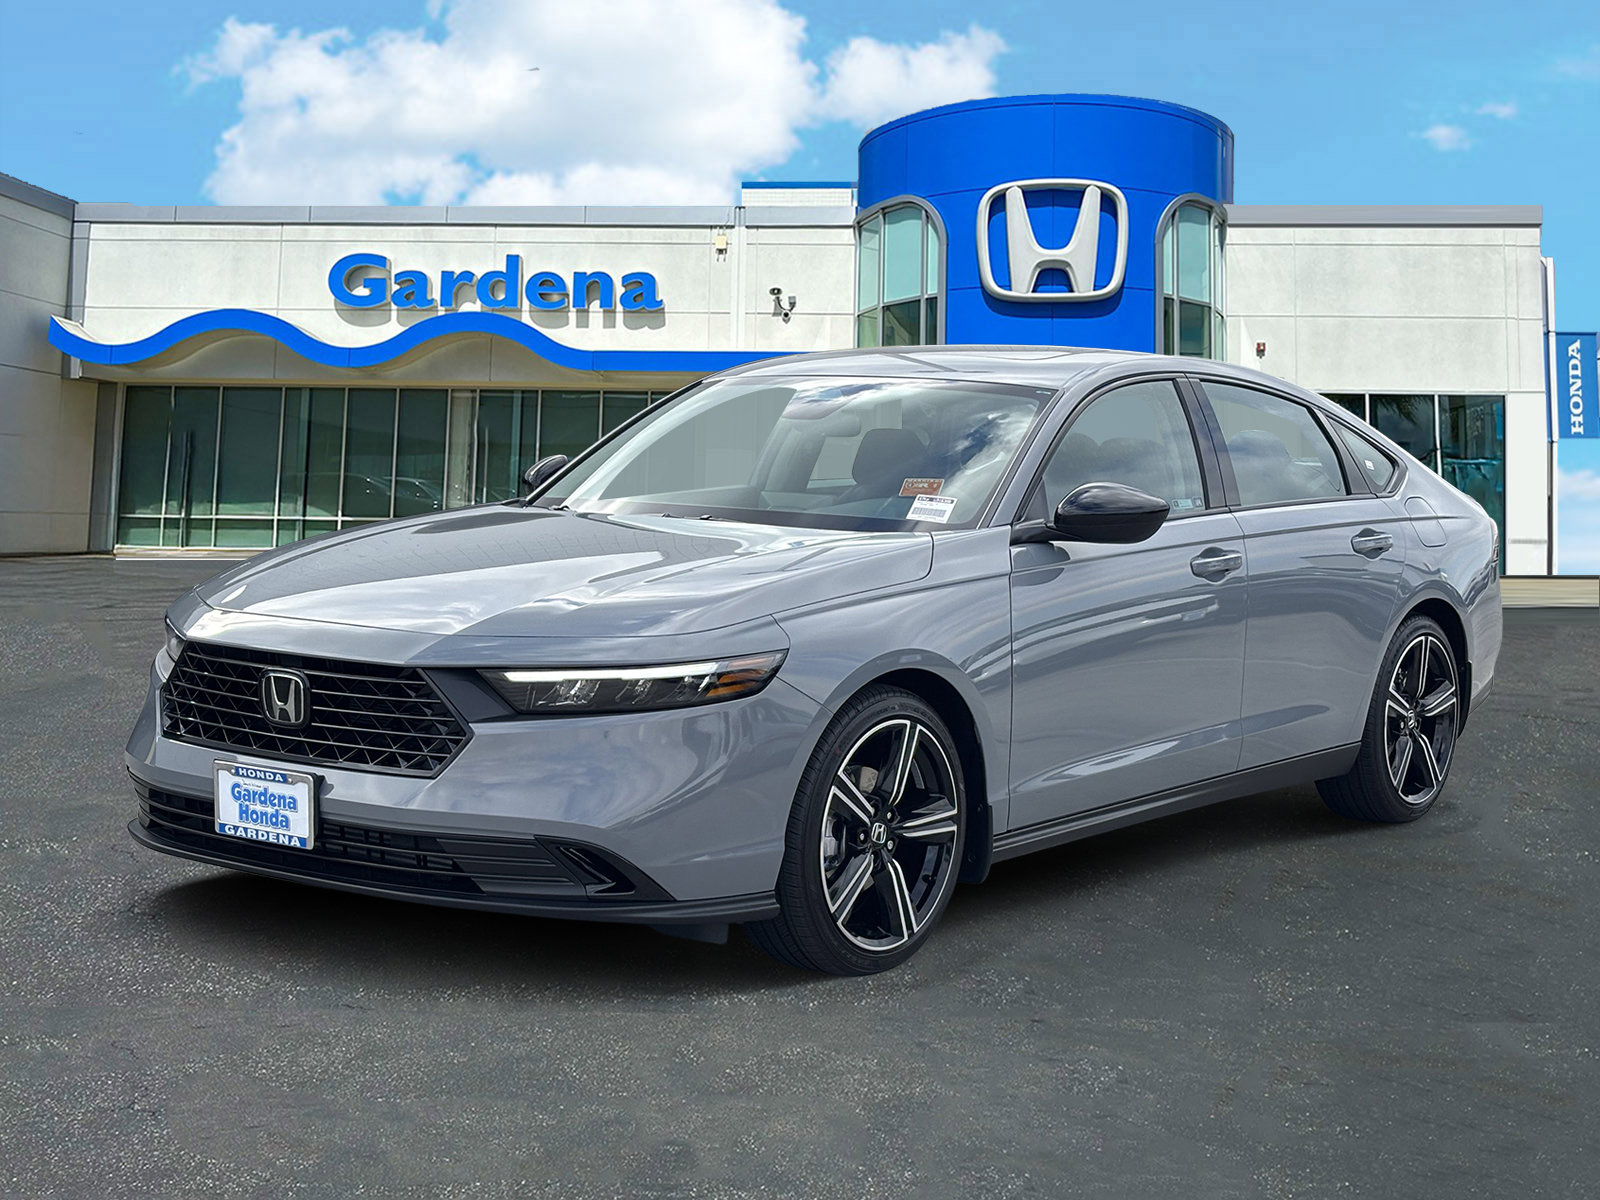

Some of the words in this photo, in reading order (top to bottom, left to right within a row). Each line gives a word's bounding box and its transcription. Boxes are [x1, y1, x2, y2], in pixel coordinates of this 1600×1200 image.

[328, 252, 664, 310] Gardena
[1568, 339, 1584, 435] HONDA
[238, 768, 284, 782] HONDA
[231, 783, 298, 812] Gardena
[238, 803, 290, 831] Honda
[224, 825, 301, 848] GARDENA
